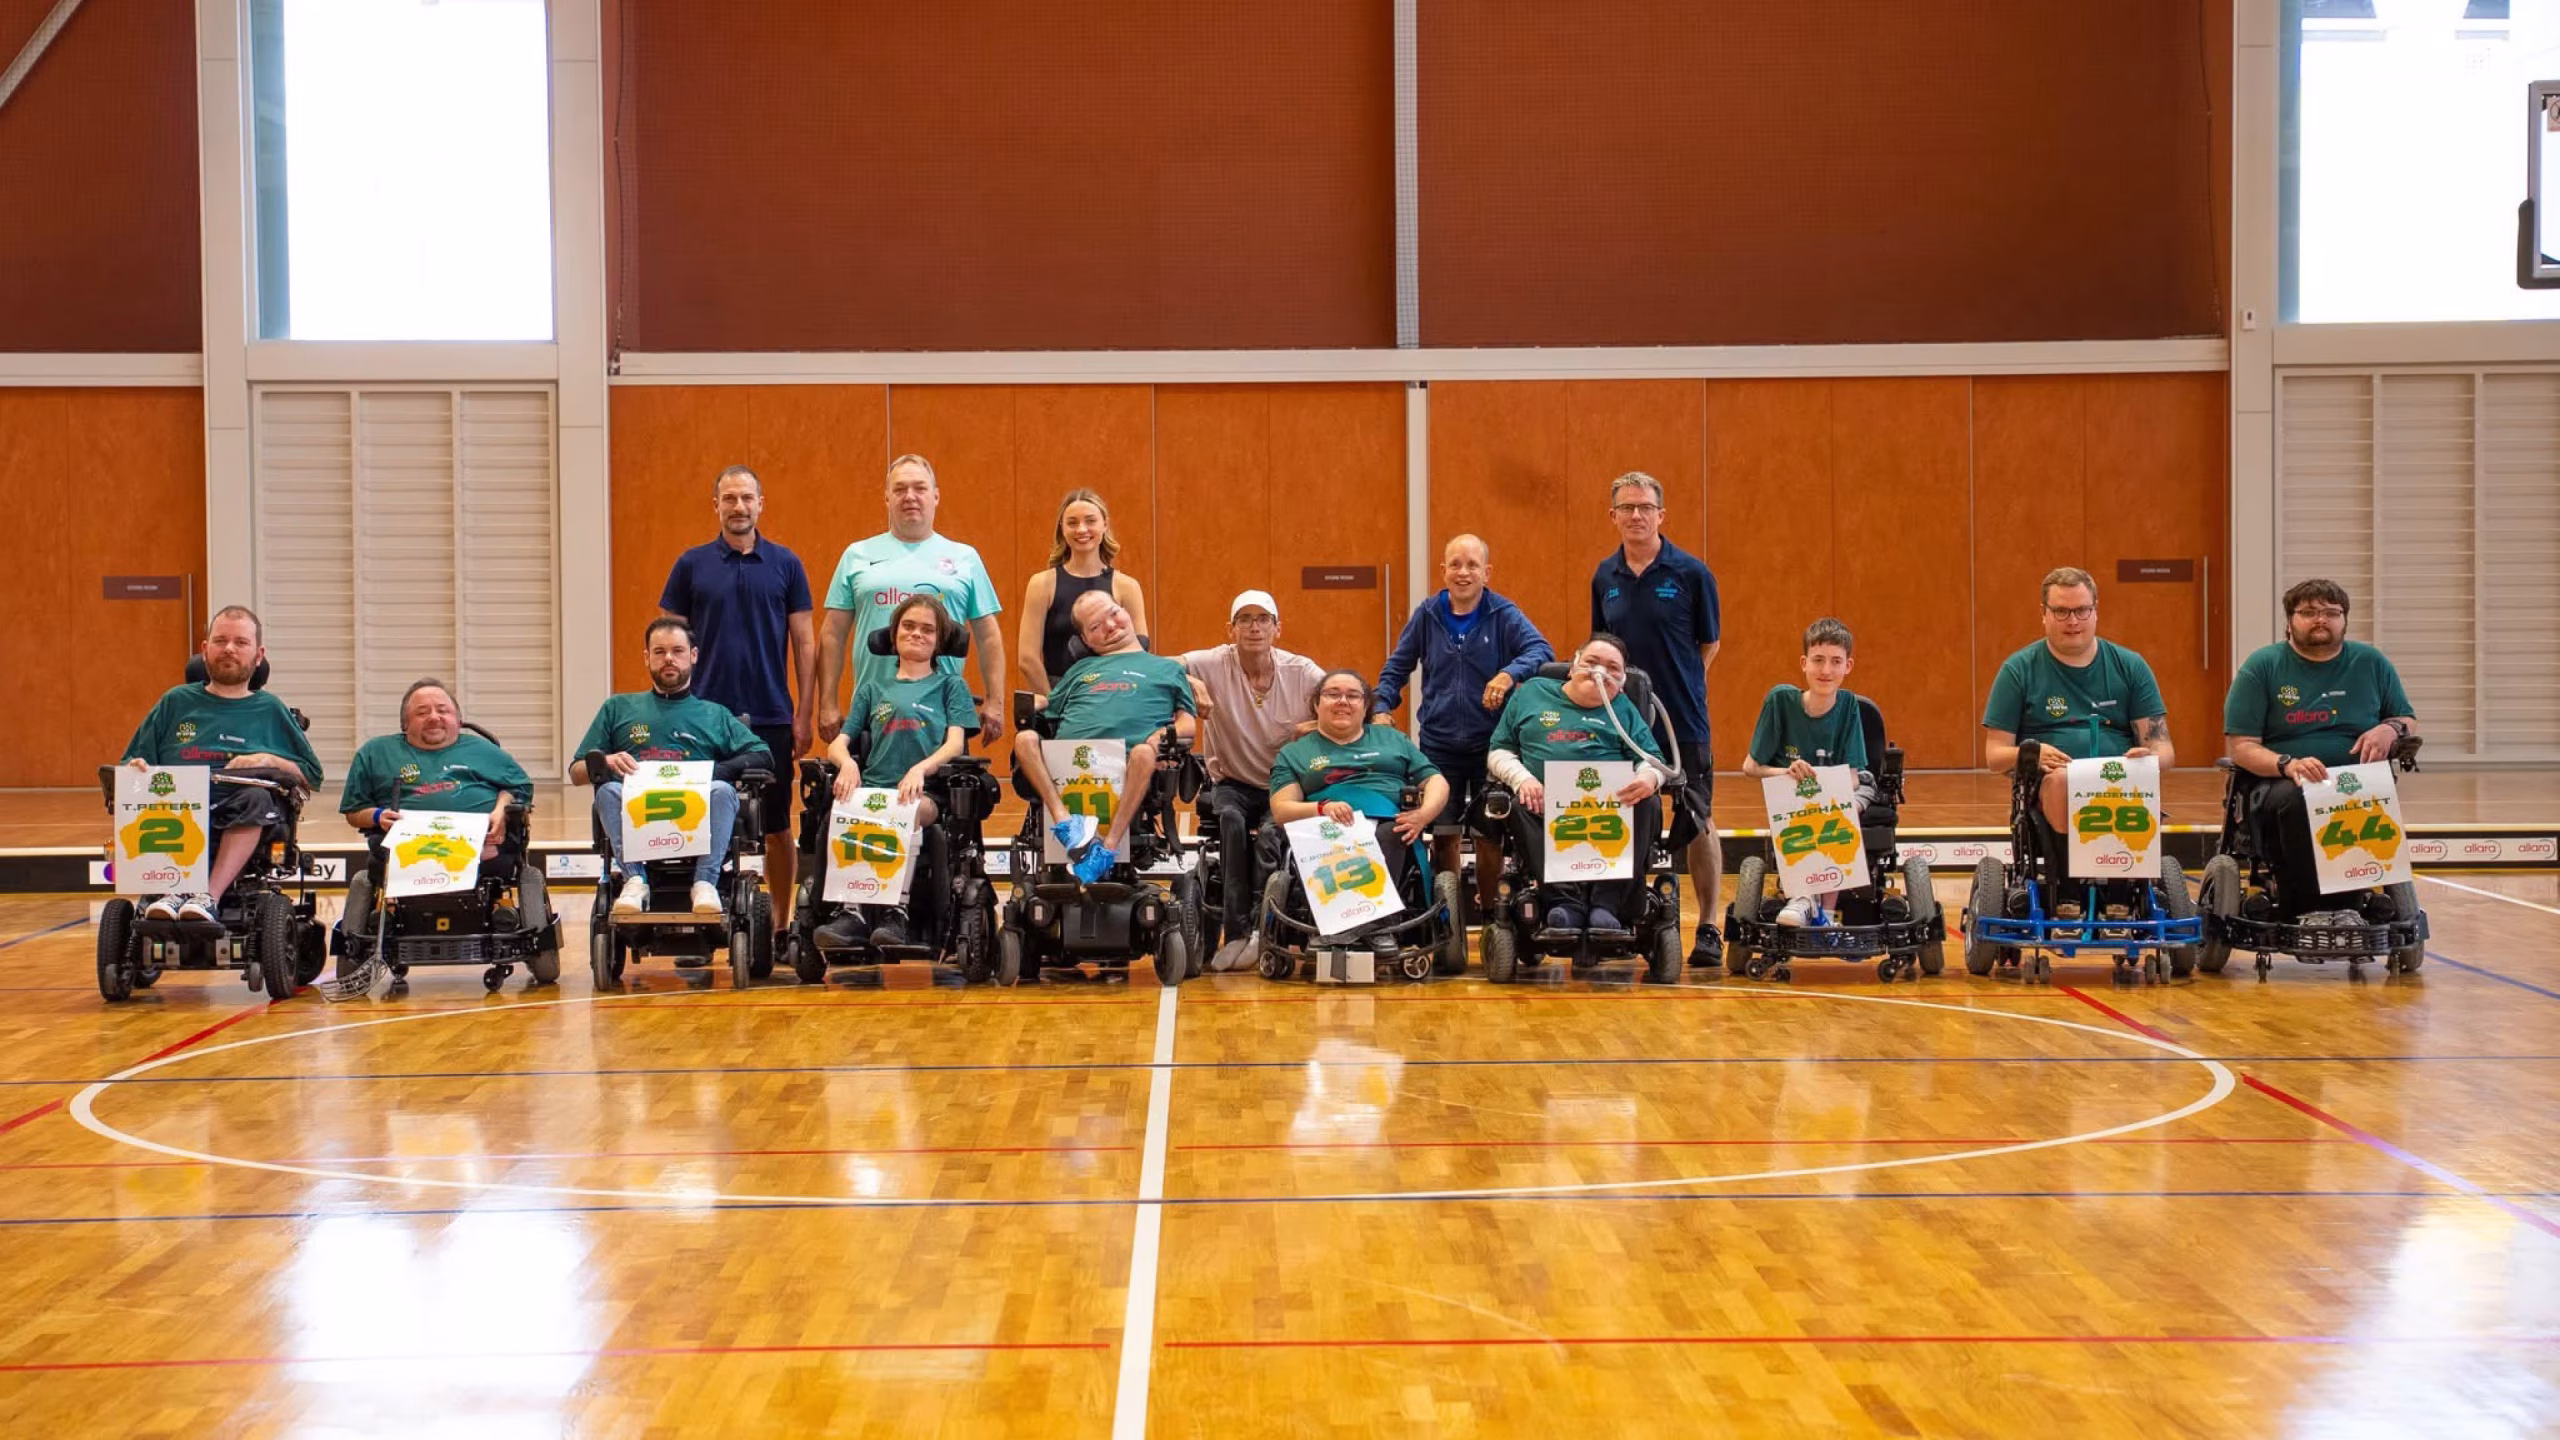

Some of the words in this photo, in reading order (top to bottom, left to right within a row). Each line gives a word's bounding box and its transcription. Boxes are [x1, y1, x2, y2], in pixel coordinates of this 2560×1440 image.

[2285, 710, 2330, 724] allara
[2074, 791, 2154, 799] A.PEDERSEN
[122, 802, 202, 811] T.PETERS
[645, 791, 687, 822] 5
[1062, 792, 1110, 824] 11
[1556, 801, 1621, 809] L.DAVID
[1772, 802, 1852, 822] S.TOPHAM
[2314, 797, 2390, 815] S.MILLETT
[2079, 806, 2150, 833] 28
[1554, 815, 1623, 840] 23
[2321, 815, 2397, 847] 44
[139, 818, 184, 853] 2
[648, 836, 680, 847] allara
[1780, 818, 1854, 854] 24
[417, 842, 452, 857] 4
[841, 833, 898, 863] 10
[1902, 847, 1932, 857] allara
[1953, 846, 1983, 856] allara
[2411, 844, 2442, 854] allara
[2464, 843, 2496, 853] allara
[2518, 842, 2550, 853] allara
[1571, 860, 1602, 871] allara
[2096, 854, 2128, 865] allara
[142, 871, 175, 881] allara
[1313, 856, 1377, 895] 13
[1806, 871, 1838, 885] allara
[2345, 865, 2377, 879] allara
[413, 876, 445, 885] allara
[848, 881, 875, 891] allara
[1341, 904, 1371, 918] allara
